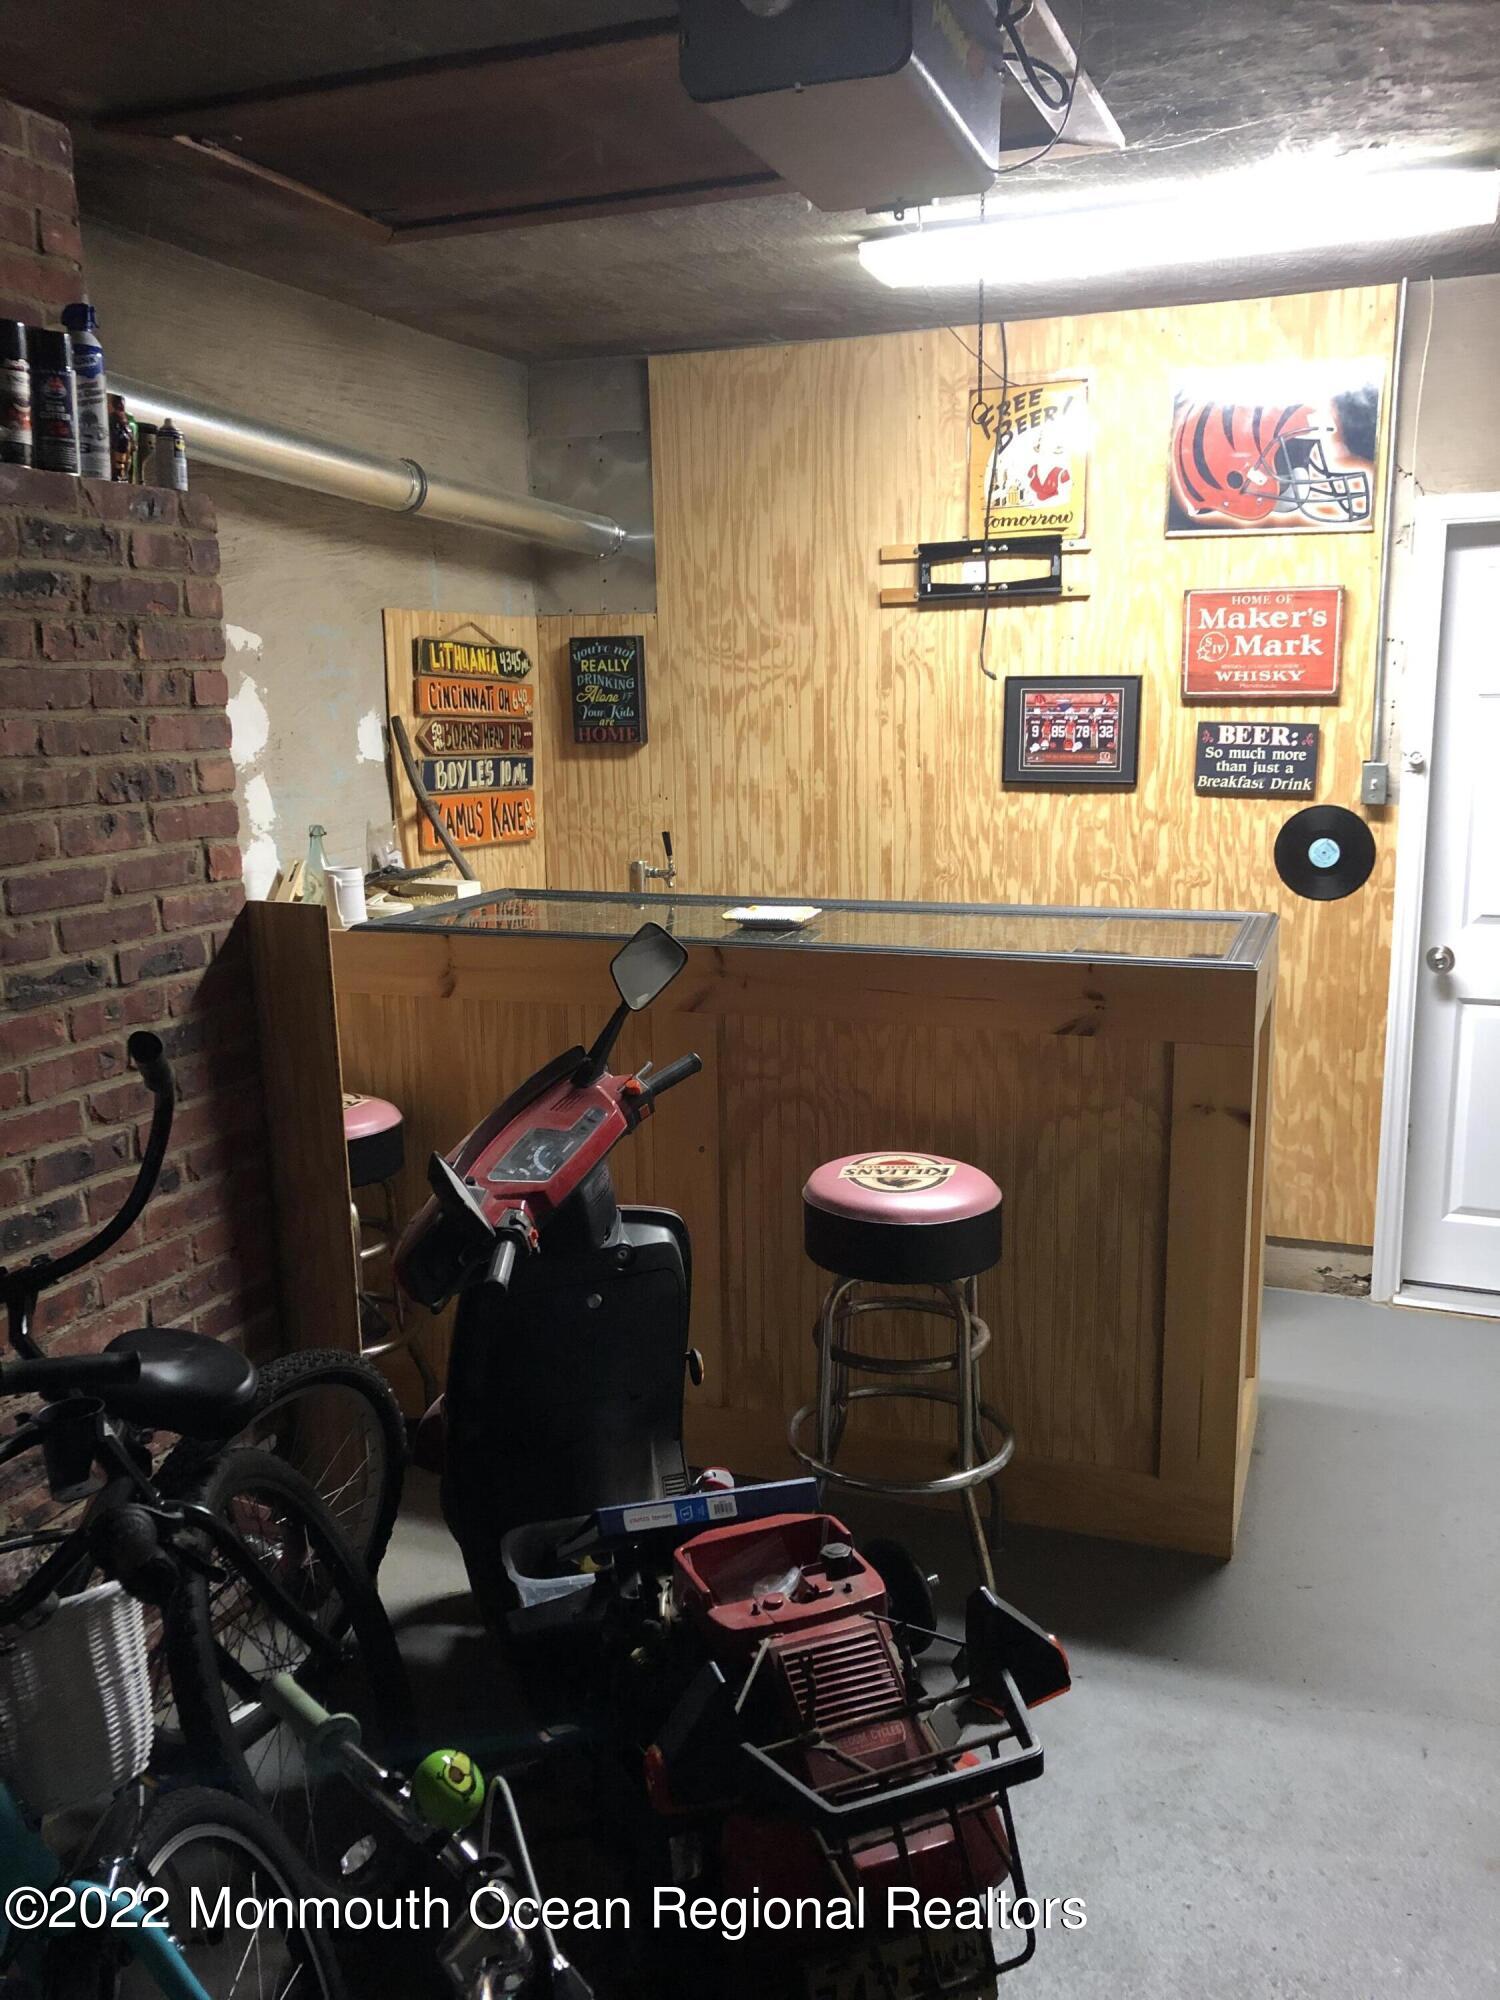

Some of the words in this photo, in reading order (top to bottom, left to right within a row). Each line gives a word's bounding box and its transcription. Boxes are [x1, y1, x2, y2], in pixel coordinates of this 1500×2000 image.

[977, 387, 1044, 440] FREE
[1231, 594, 1272, 605] HOME
[1275, 593, 1296, 605] OF
[1197, 606, 1328, 630] Maker's
[613, 645, 636, 660] not
[1231, 633, 1324, 658] Mark
[499, 650, 521, 674] 4345
[581, 658, 630, 672] REALLY
[576, 673, 635, 690] DRINKING
[1214, 670, 1306, 682] WHISKY
[498, 688, 511, 713] OH
[575, 684, 620, 703] Alone
[580, 704, 605, 720] Your
[610, 703, 635, 719] Kids
[598, 718, 615, 726] are
[579, 726, 638, 742] HOME
[1031, 725, 1040, 738] 9
[1051, 725, 1065, 738] 85
[1075, 725, 1091, 738] 78
[1098, 725, 1114, 738] 32
[1216, 724, 1299, 747] BEER:
[1204, 746, 1224, 759] So
[1228, 747, 1266, 760] much
[1271, 750, 1307, 761] more
[500, 760, 512, 786] 10
[1216, 760, 1247, 772] than
[1251, 761, 1280, 775] just
[1284, 764, 1295, 774] a
[1197, 775, 1266, 789] Breakfast
[1270, 777, 1313, 791] Drink
[489, 796, 524, 840] KAVE
